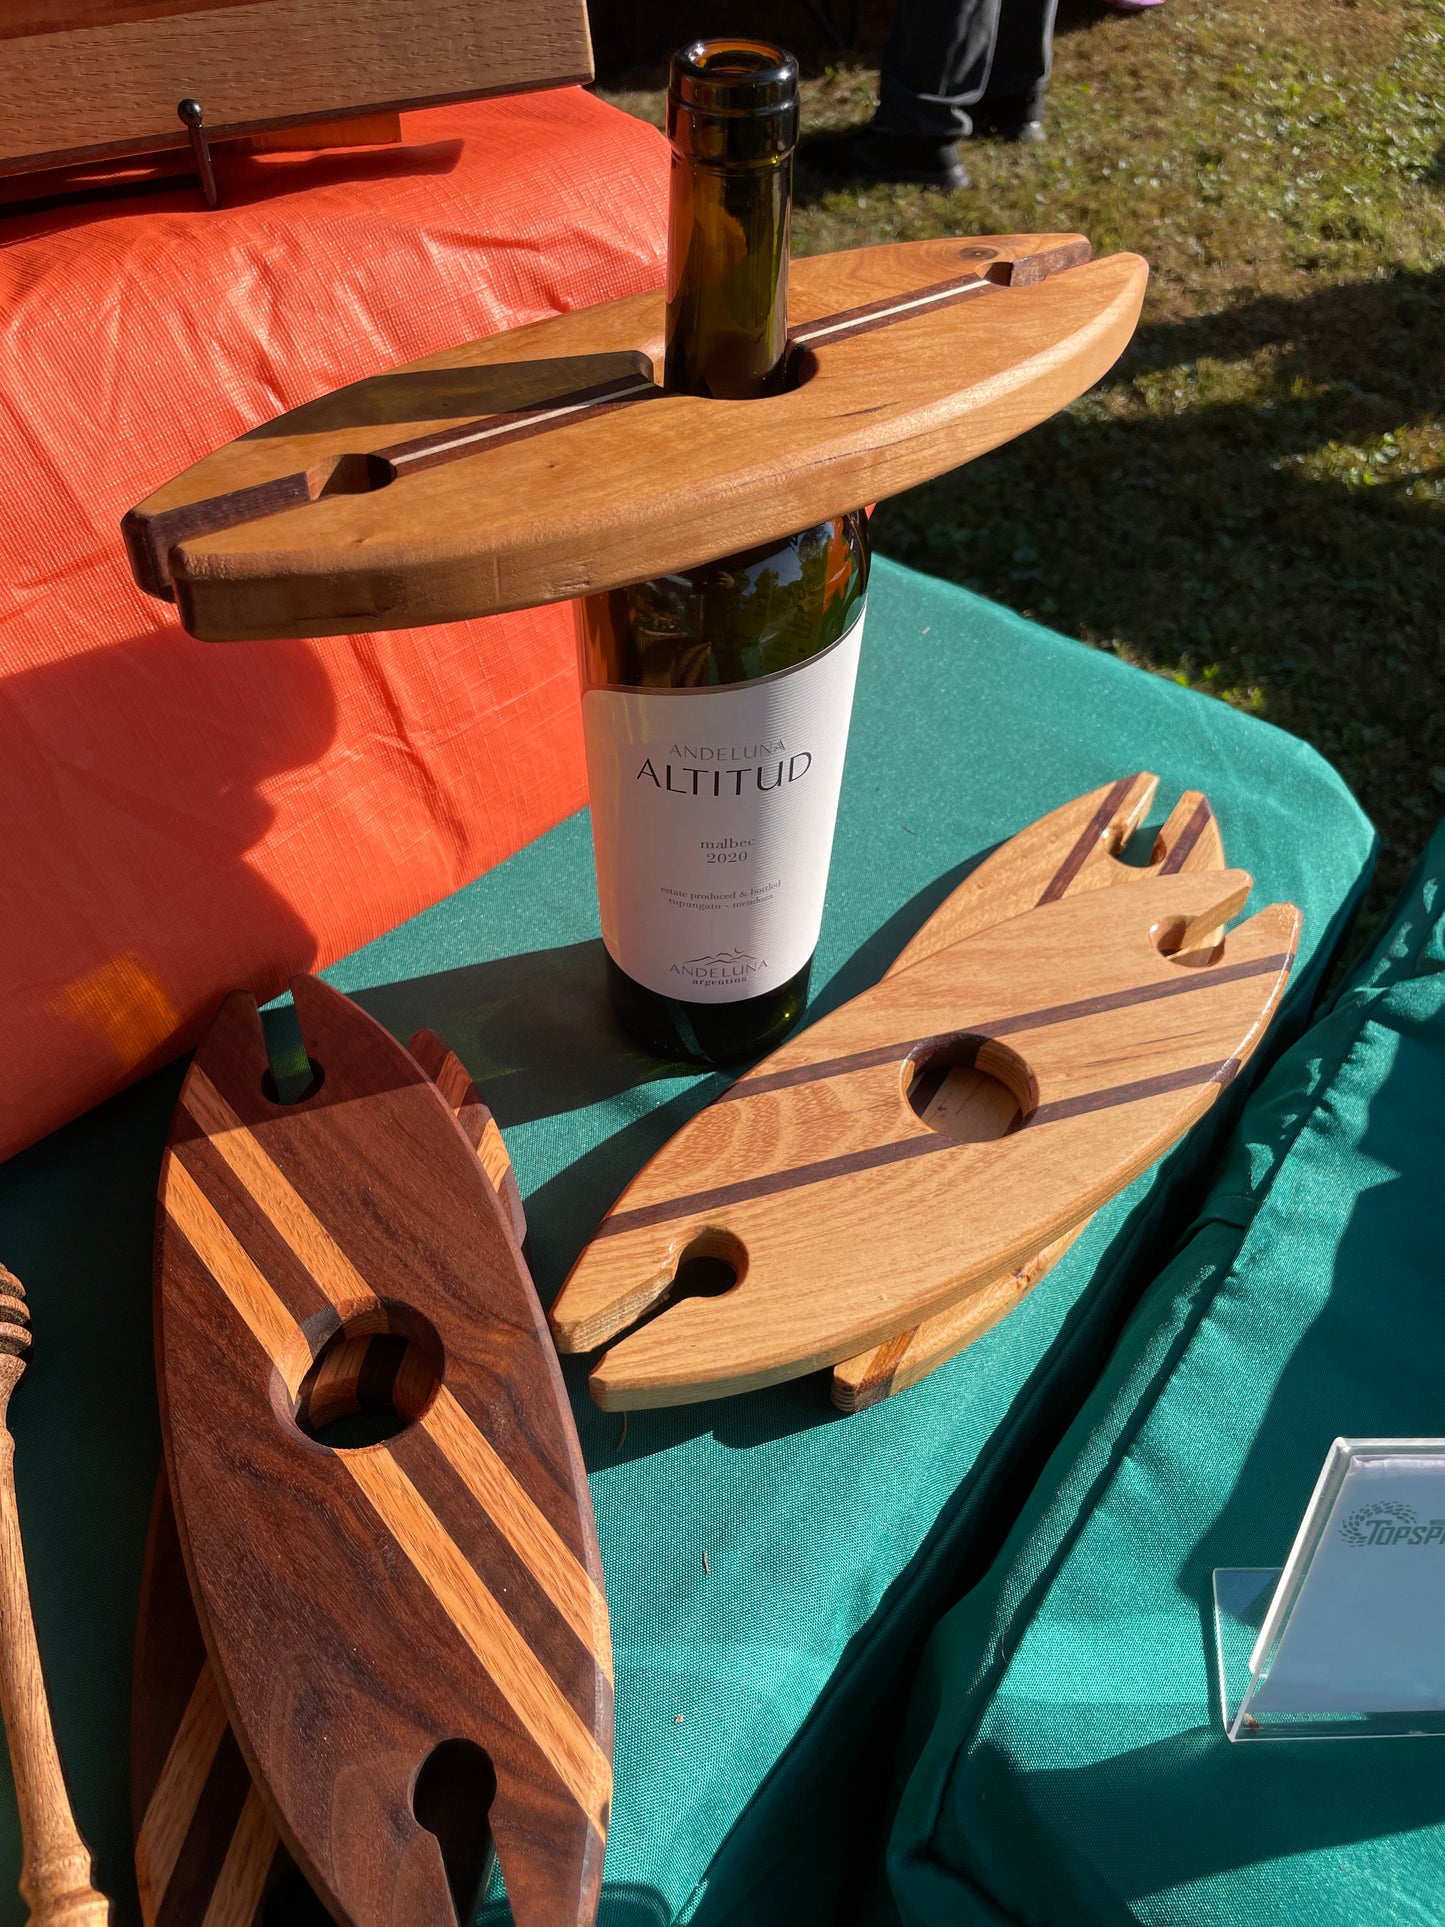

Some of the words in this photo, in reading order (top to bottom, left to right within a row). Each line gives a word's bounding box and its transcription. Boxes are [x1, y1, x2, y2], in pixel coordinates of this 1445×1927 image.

[669, 739, 786, 761] ANDELUNA
[636, 751, 813, 797] ALTITUD
[700, 837, 756, 850] malbec
[706, 851, 748, 864] 2020
[660, 887, 688, 898] estate
[690, 891, 736, 901] produced
[739, 890, 747, 898] &
[750, 879, 782, 896] bottled
[668, 898, 721, 911] tupungato
[732, 893, 774, 908] mendoza
[669, 959, 768, 978] ANDELUNA
[692, 977, 748, 987] argentina
